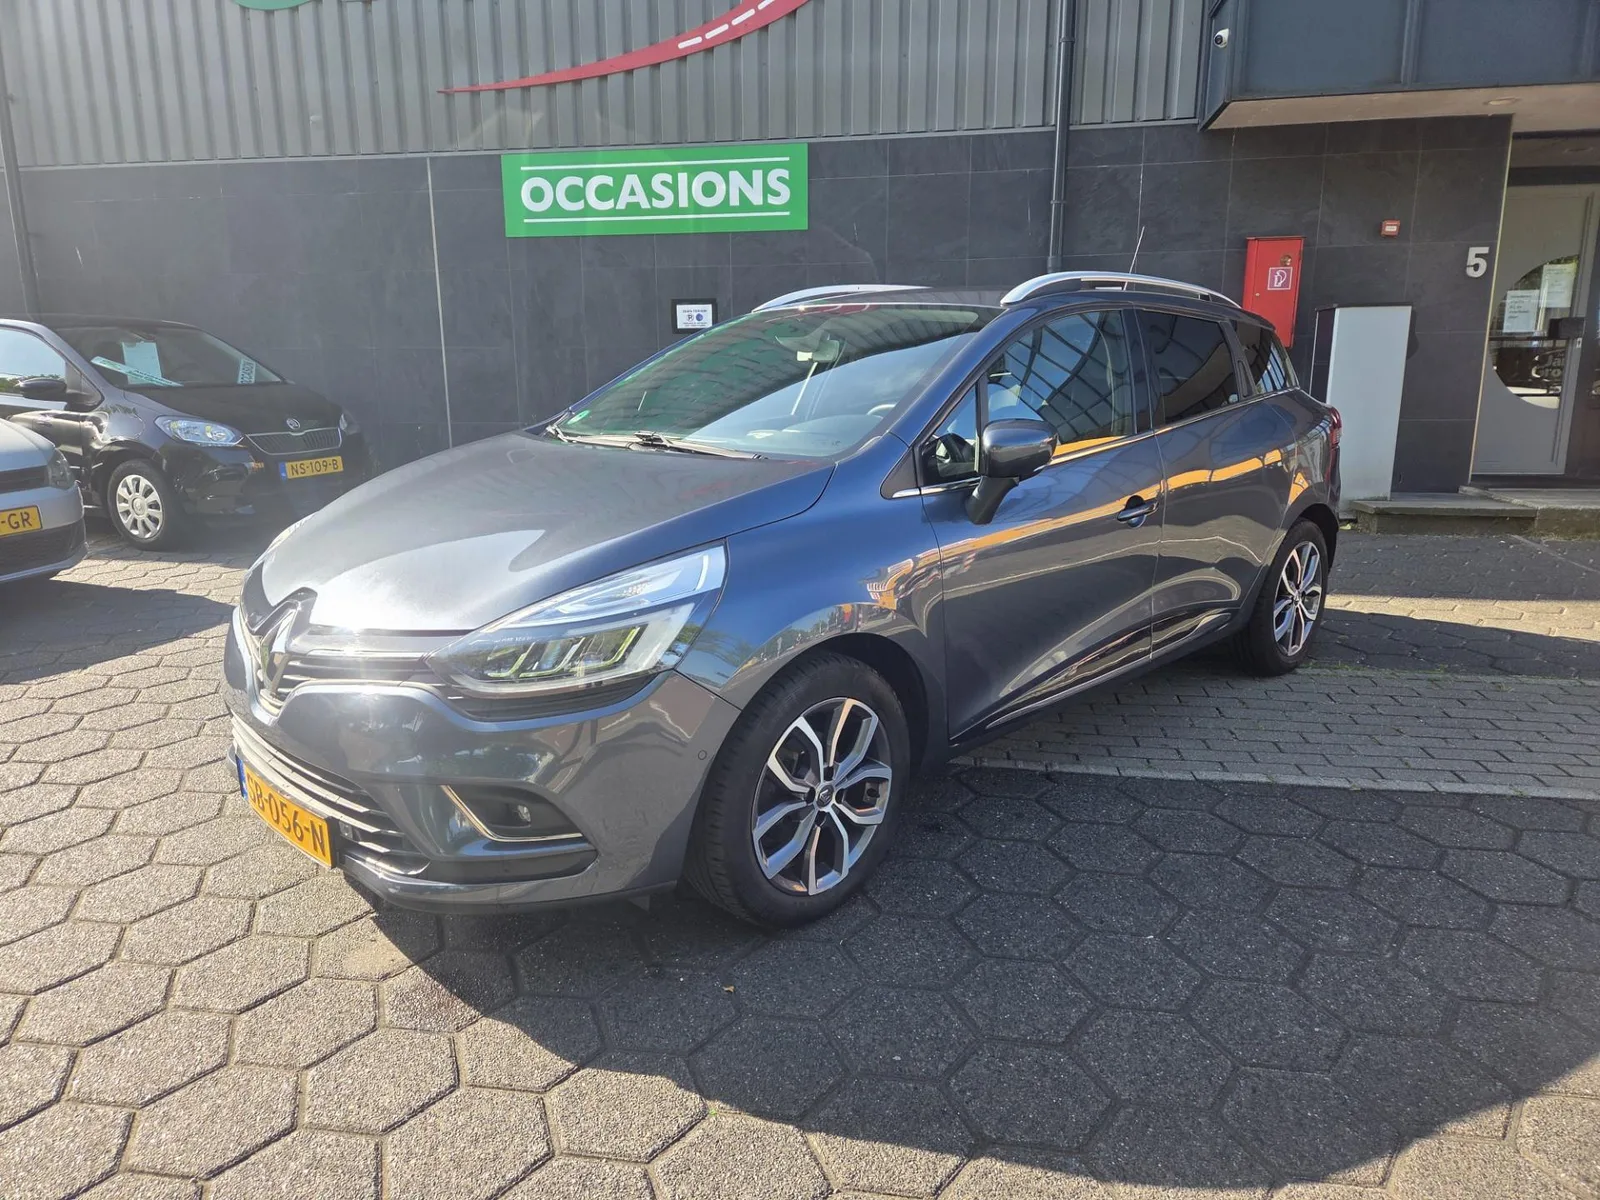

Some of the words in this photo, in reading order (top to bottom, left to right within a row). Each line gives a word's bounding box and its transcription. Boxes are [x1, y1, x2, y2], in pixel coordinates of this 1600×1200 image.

[520, 168, 791, 212] OCCASIONS
[1465, 246, 1490, 278] 5
[290, 459, 339, 476] NS-109-B
